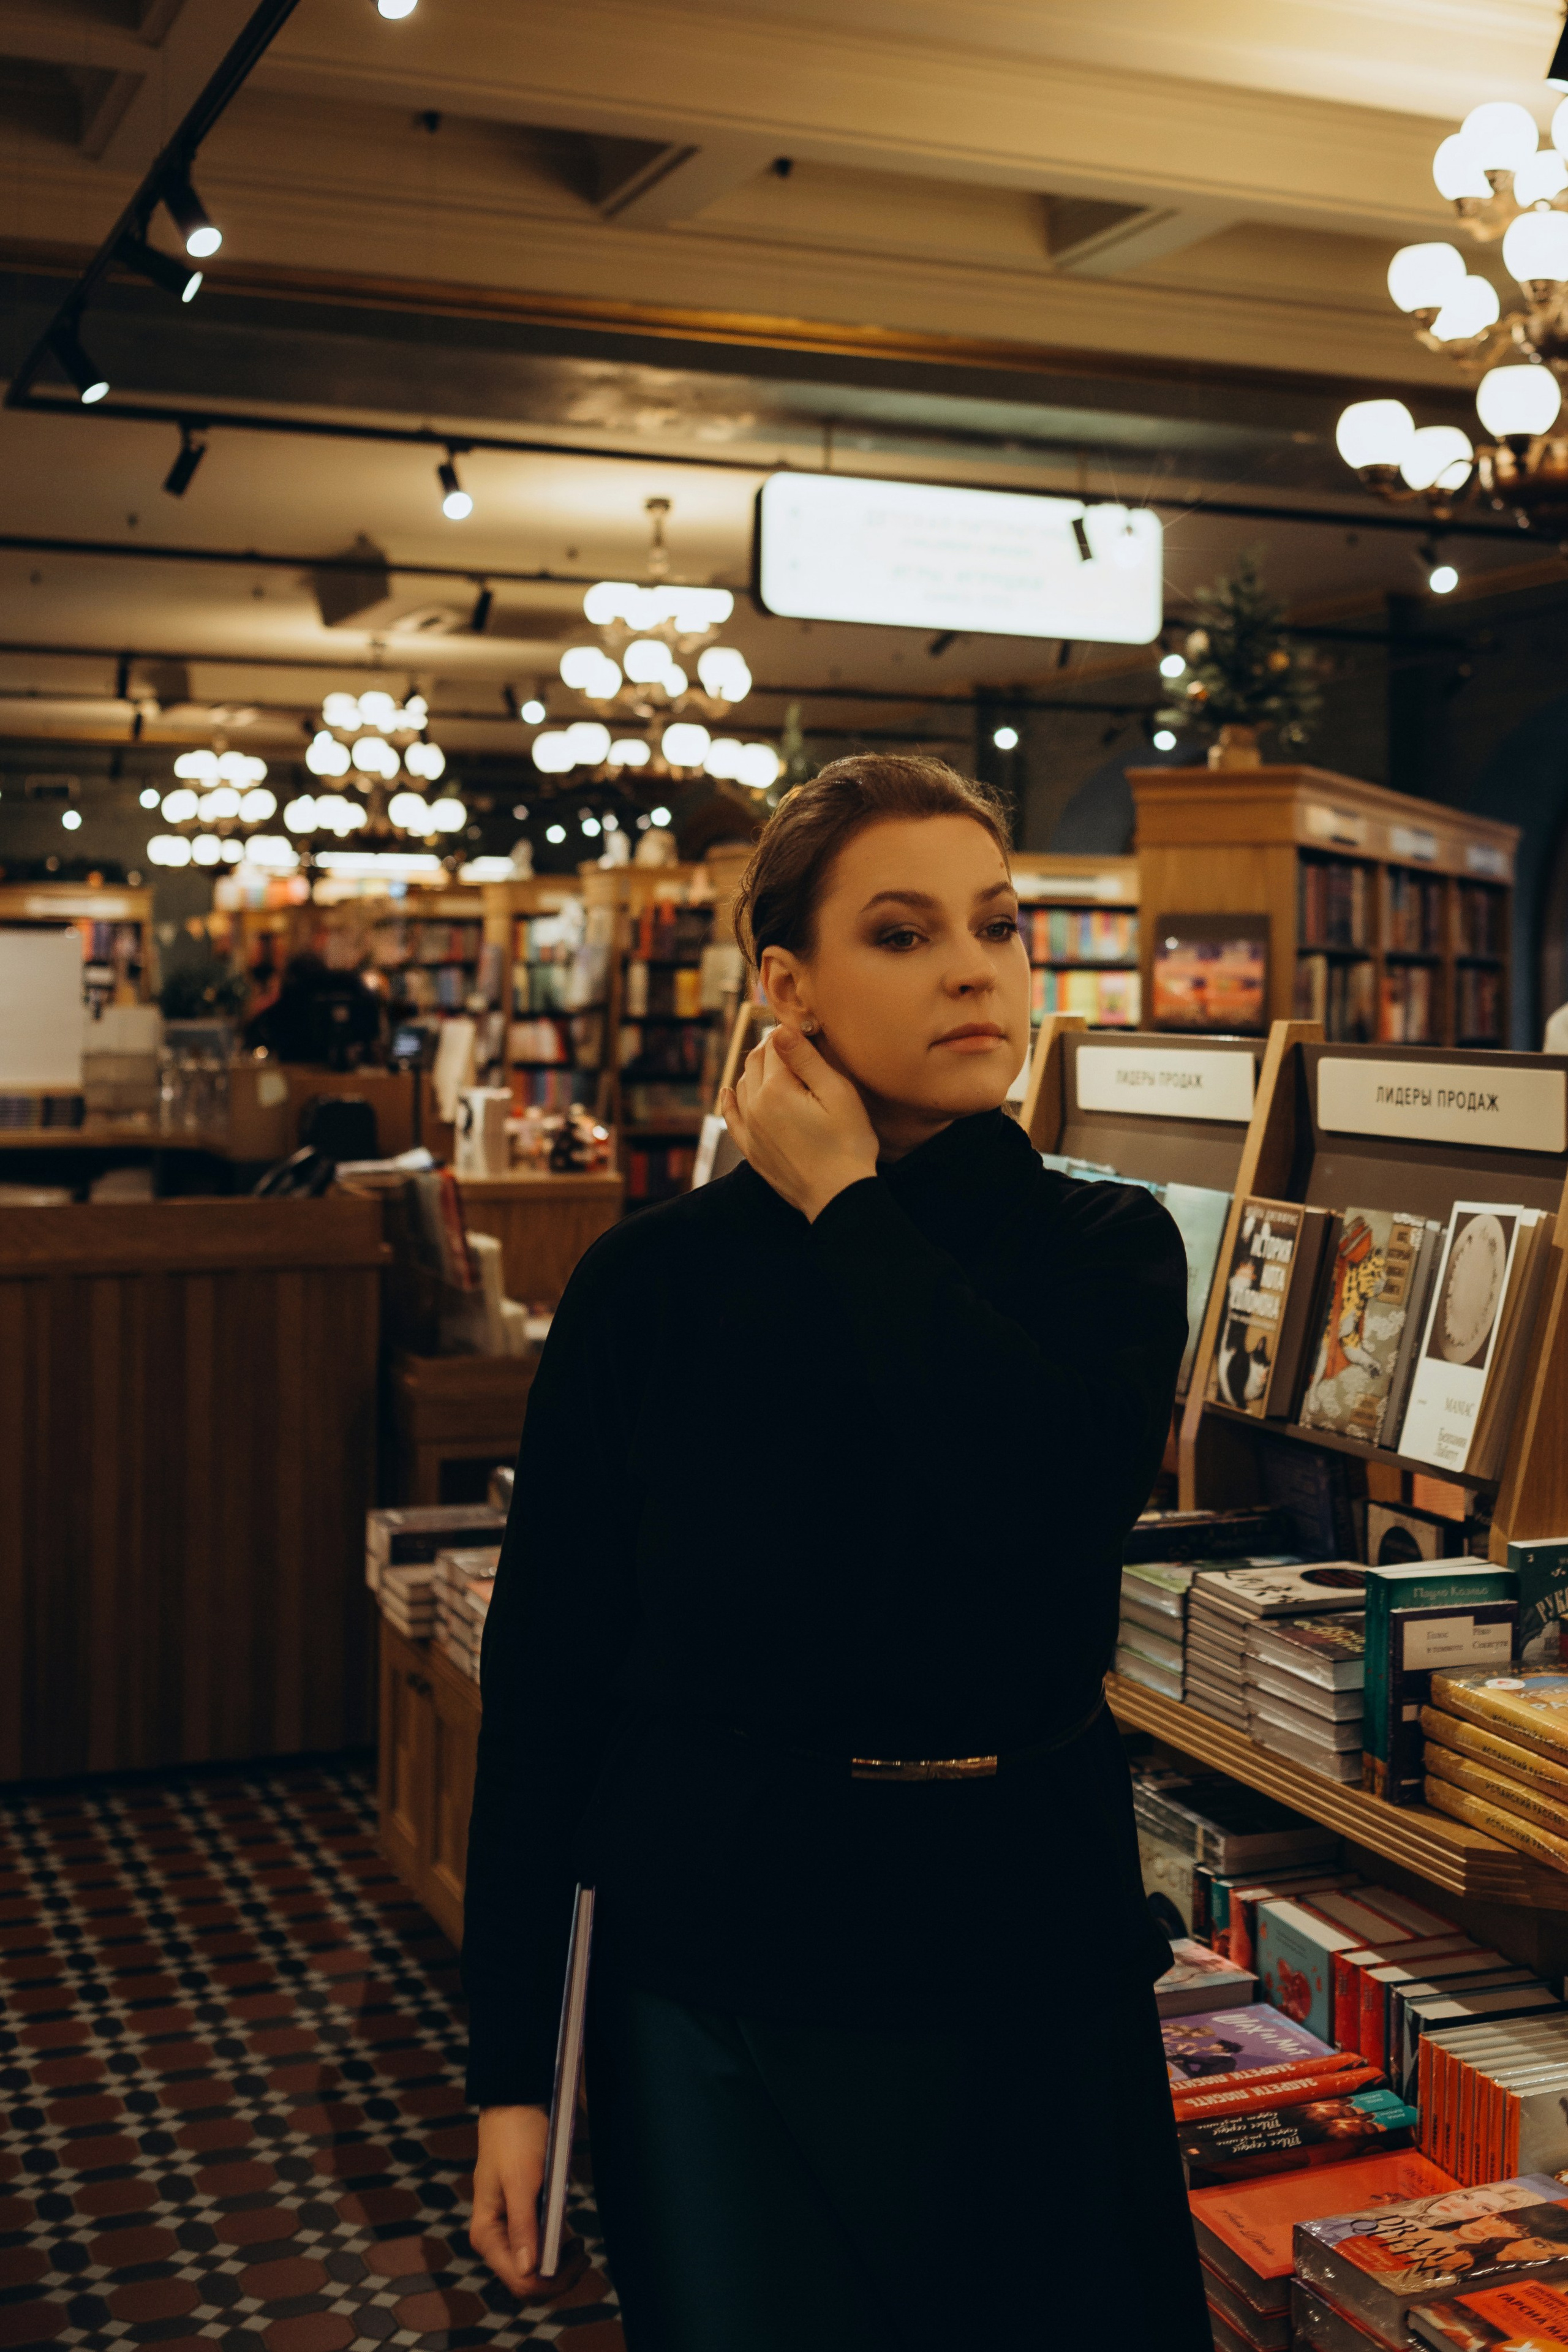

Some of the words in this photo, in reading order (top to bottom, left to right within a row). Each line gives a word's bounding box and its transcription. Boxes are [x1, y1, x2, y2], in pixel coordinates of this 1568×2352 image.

[1376, 1085, 1431, 1107] ЛИДЕРЫ
[1438, 1090, 1499, 1113] ПРОДАЖ
[1230, 2062, 1296, 2081] ЗАПРЕТИ
[1185, 2090, 1249, 2108] ЛЮБИТЬ
[1251, 2077, 1318, 2097] ЗАПРЕТИ
[1351, 2219, 1442, 2272] QUEEN
[1375, 2215, 1471, 2272] DRAMA
